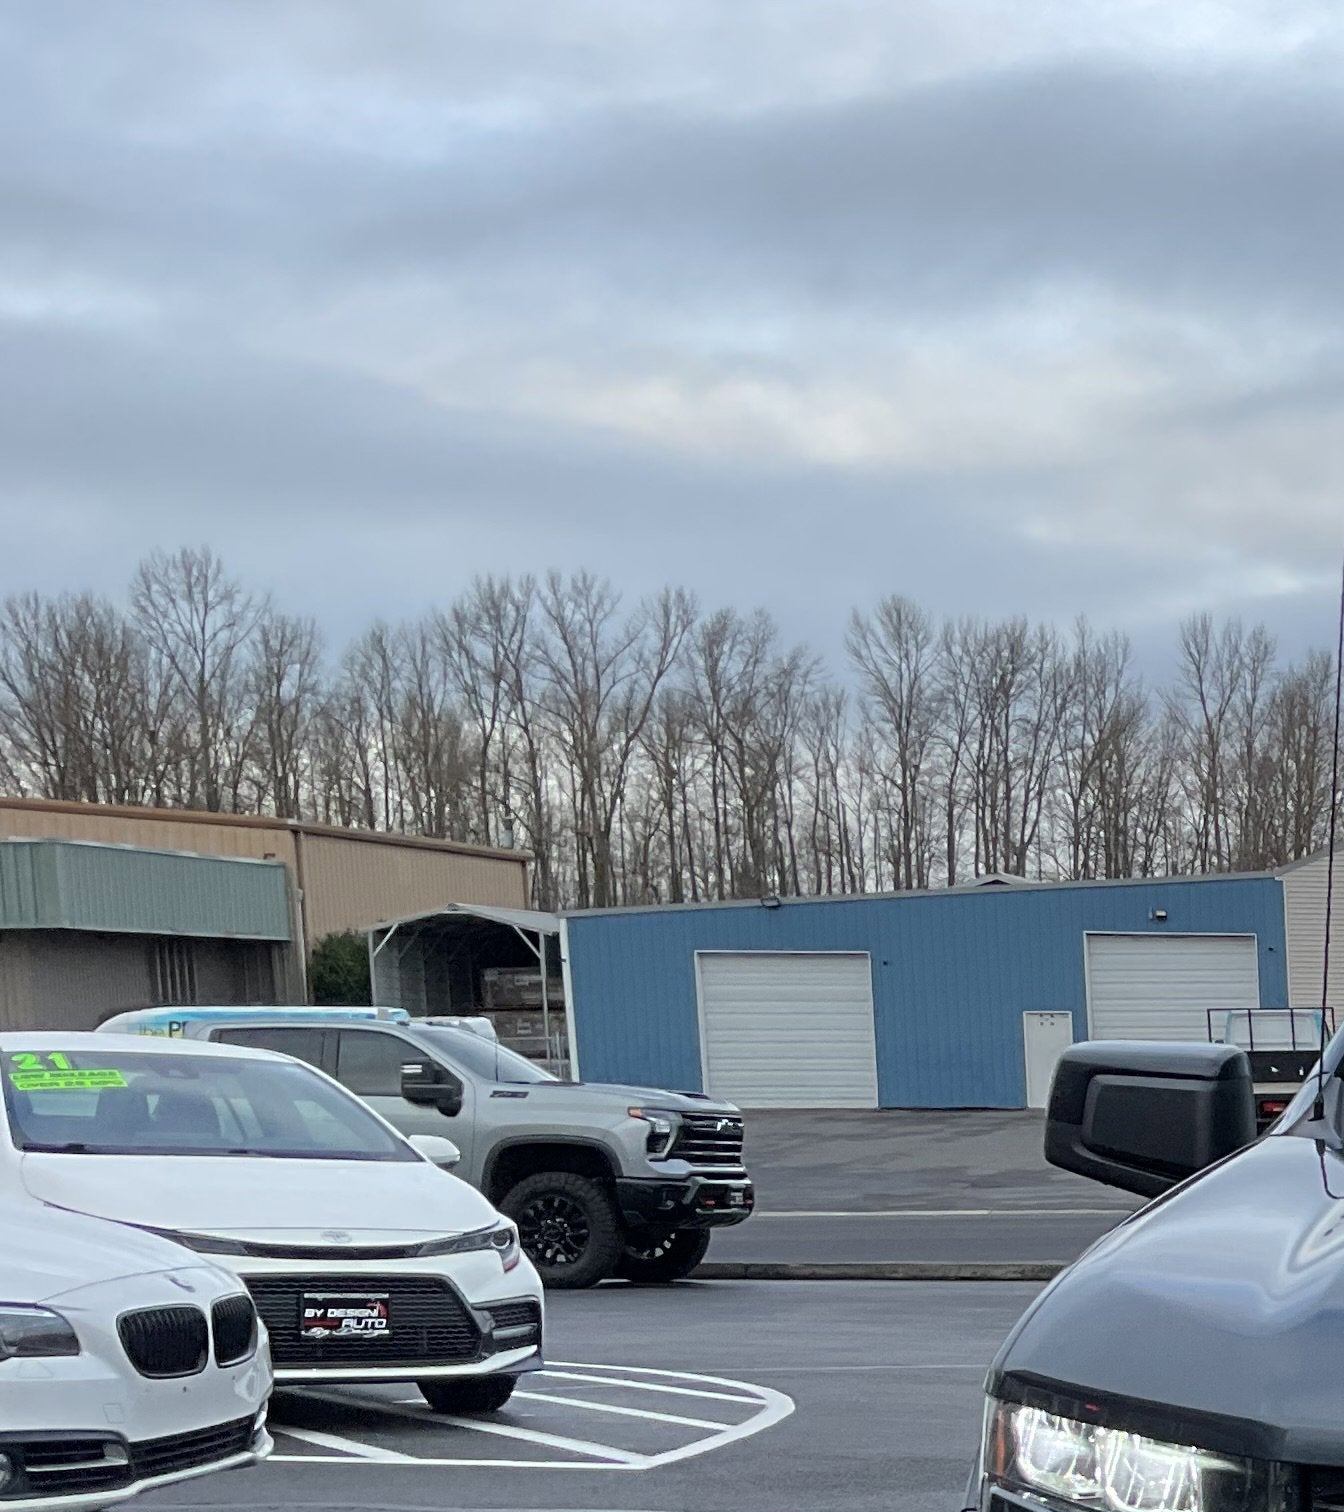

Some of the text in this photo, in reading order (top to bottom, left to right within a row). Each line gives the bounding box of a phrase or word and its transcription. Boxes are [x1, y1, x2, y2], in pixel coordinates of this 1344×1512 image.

[10, 1052, 72, 1070] 21
[304, 1308, 377, 1318] BY DESIGN
[341, 1318, 387, 1328] AUTO
